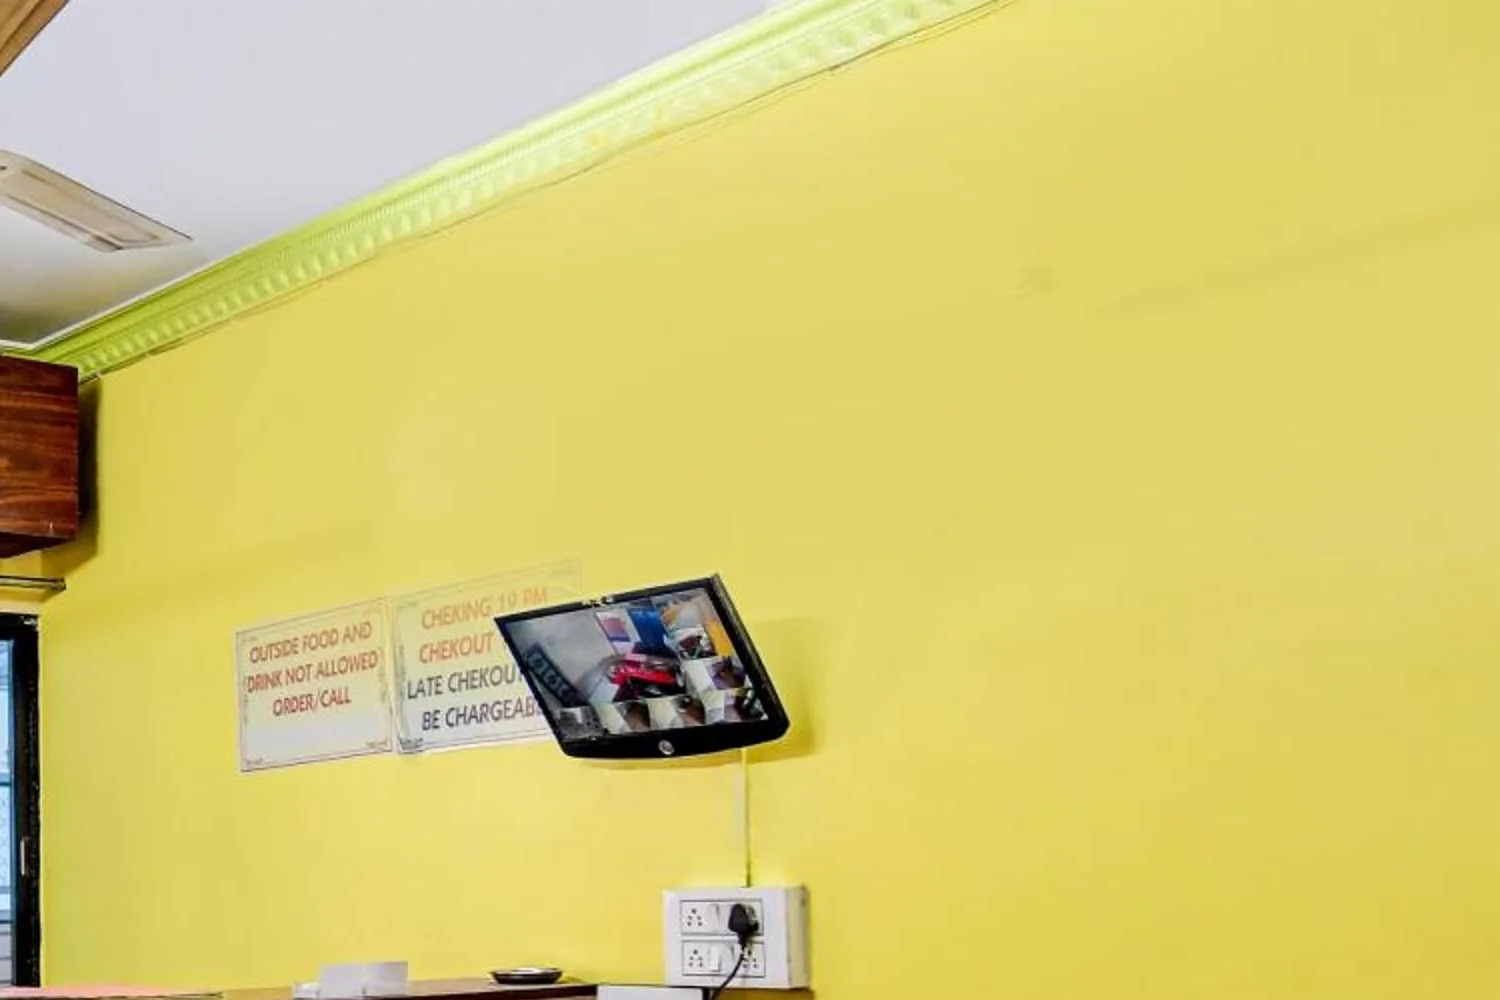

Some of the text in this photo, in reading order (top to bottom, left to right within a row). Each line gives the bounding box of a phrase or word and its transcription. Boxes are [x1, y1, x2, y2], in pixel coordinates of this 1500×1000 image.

[421, 596, 491, 630] CHEKING
[250, 620, 373, 663] OUTSIDE FOOD AND
[419, 631, 494, 664] CHEKOUT
[247, 650, 379, 693] DRINK NOT ALLOWED
[407, 674, 443, 699] LATE
[447, 664, 523, 693] CHEKOU
[273, 686, 352, 716] ORDER/CALL
[422, 708, 441, 731] BE
